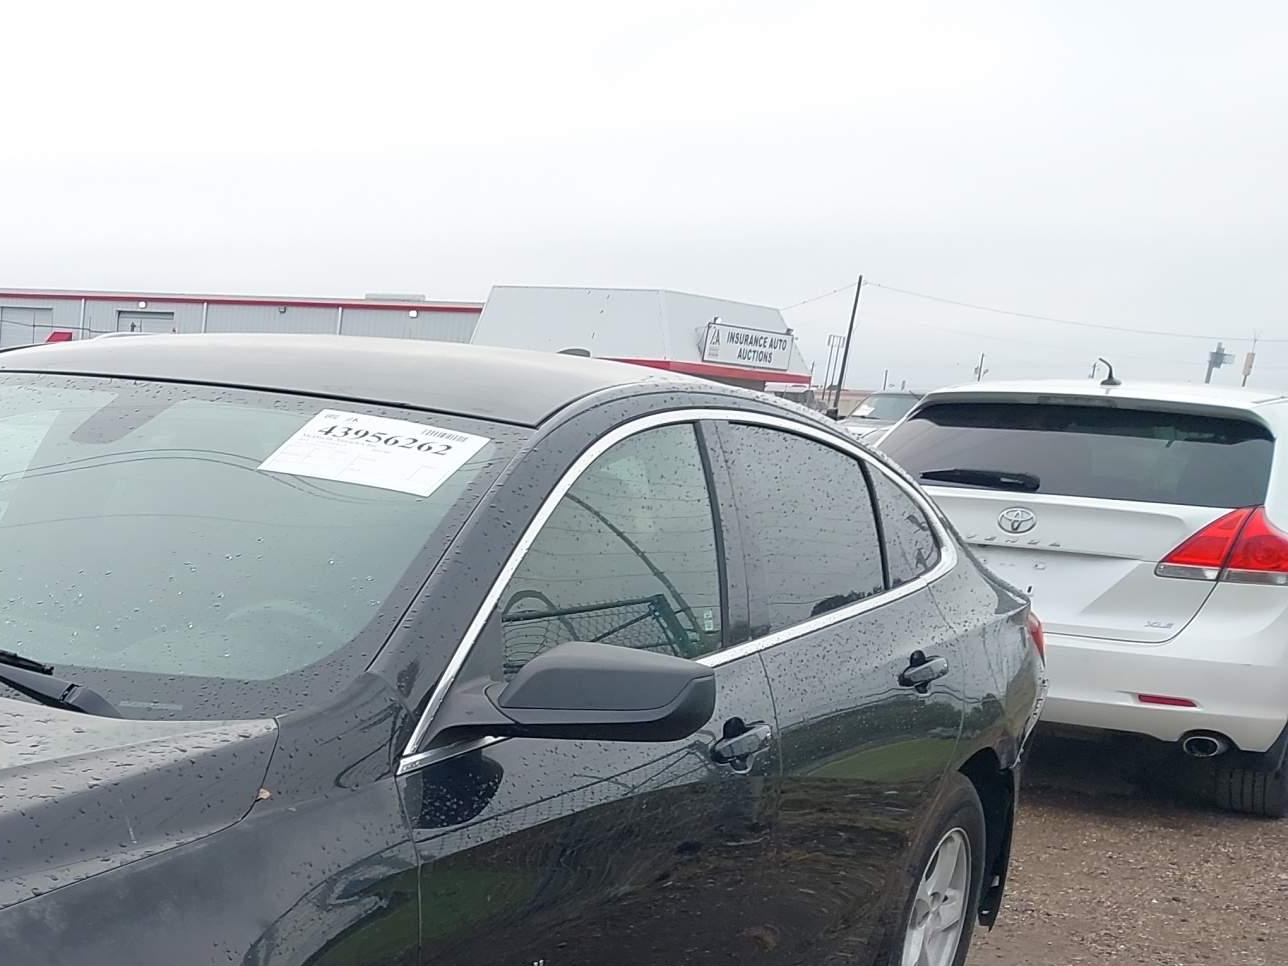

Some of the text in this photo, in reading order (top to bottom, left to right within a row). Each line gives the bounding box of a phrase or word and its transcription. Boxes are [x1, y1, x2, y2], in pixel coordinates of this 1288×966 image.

[726, 331, 788, 351] INSURANCE AUTO
[737, 347, 773, 363] AUCTIONS
[318, 424, 454, 456] 43956262
